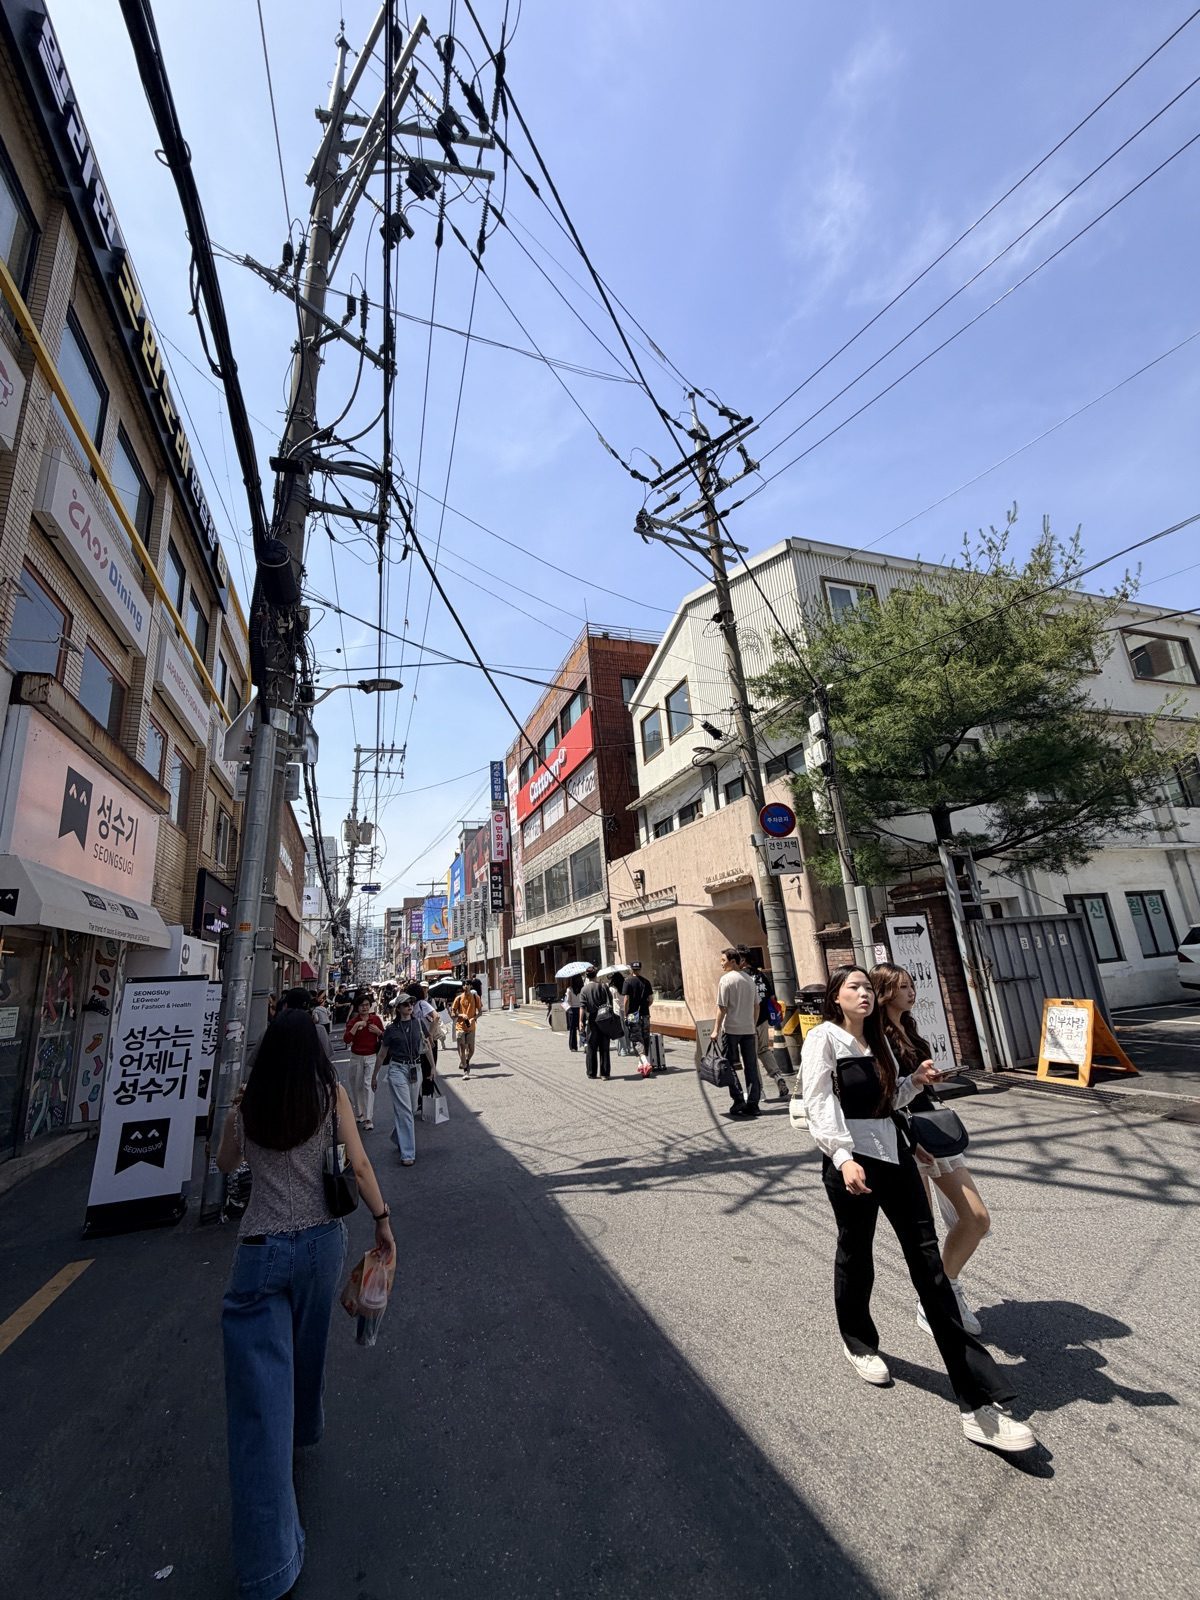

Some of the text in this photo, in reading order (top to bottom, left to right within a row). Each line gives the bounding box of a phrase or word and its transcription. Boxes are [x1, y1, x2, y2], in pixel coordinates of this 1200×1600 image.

[109, 561, 143, 632] Dining
[97, 795, 138, 855] 성수기
[767, 815, 789, 823] 주차금지
[495, 826, 504, 857] 만화카페
[769, 841, 797, 850] 견인지역
[93, 843, 134, 876] SEONGSUGI
[1090, 901, 1104, 919] 산
[133, 989, 170, 997] SEONGSUgi
[1049, 1014, 1085, 1030] 외부차량
[122, 1025, 194, 1051] 성수는
[119, 1048, 192, 1077] 언제나
[113, 1074, 187, 1105] 성수기
[123, 1140, 163, 1154] SEONGSUGI
